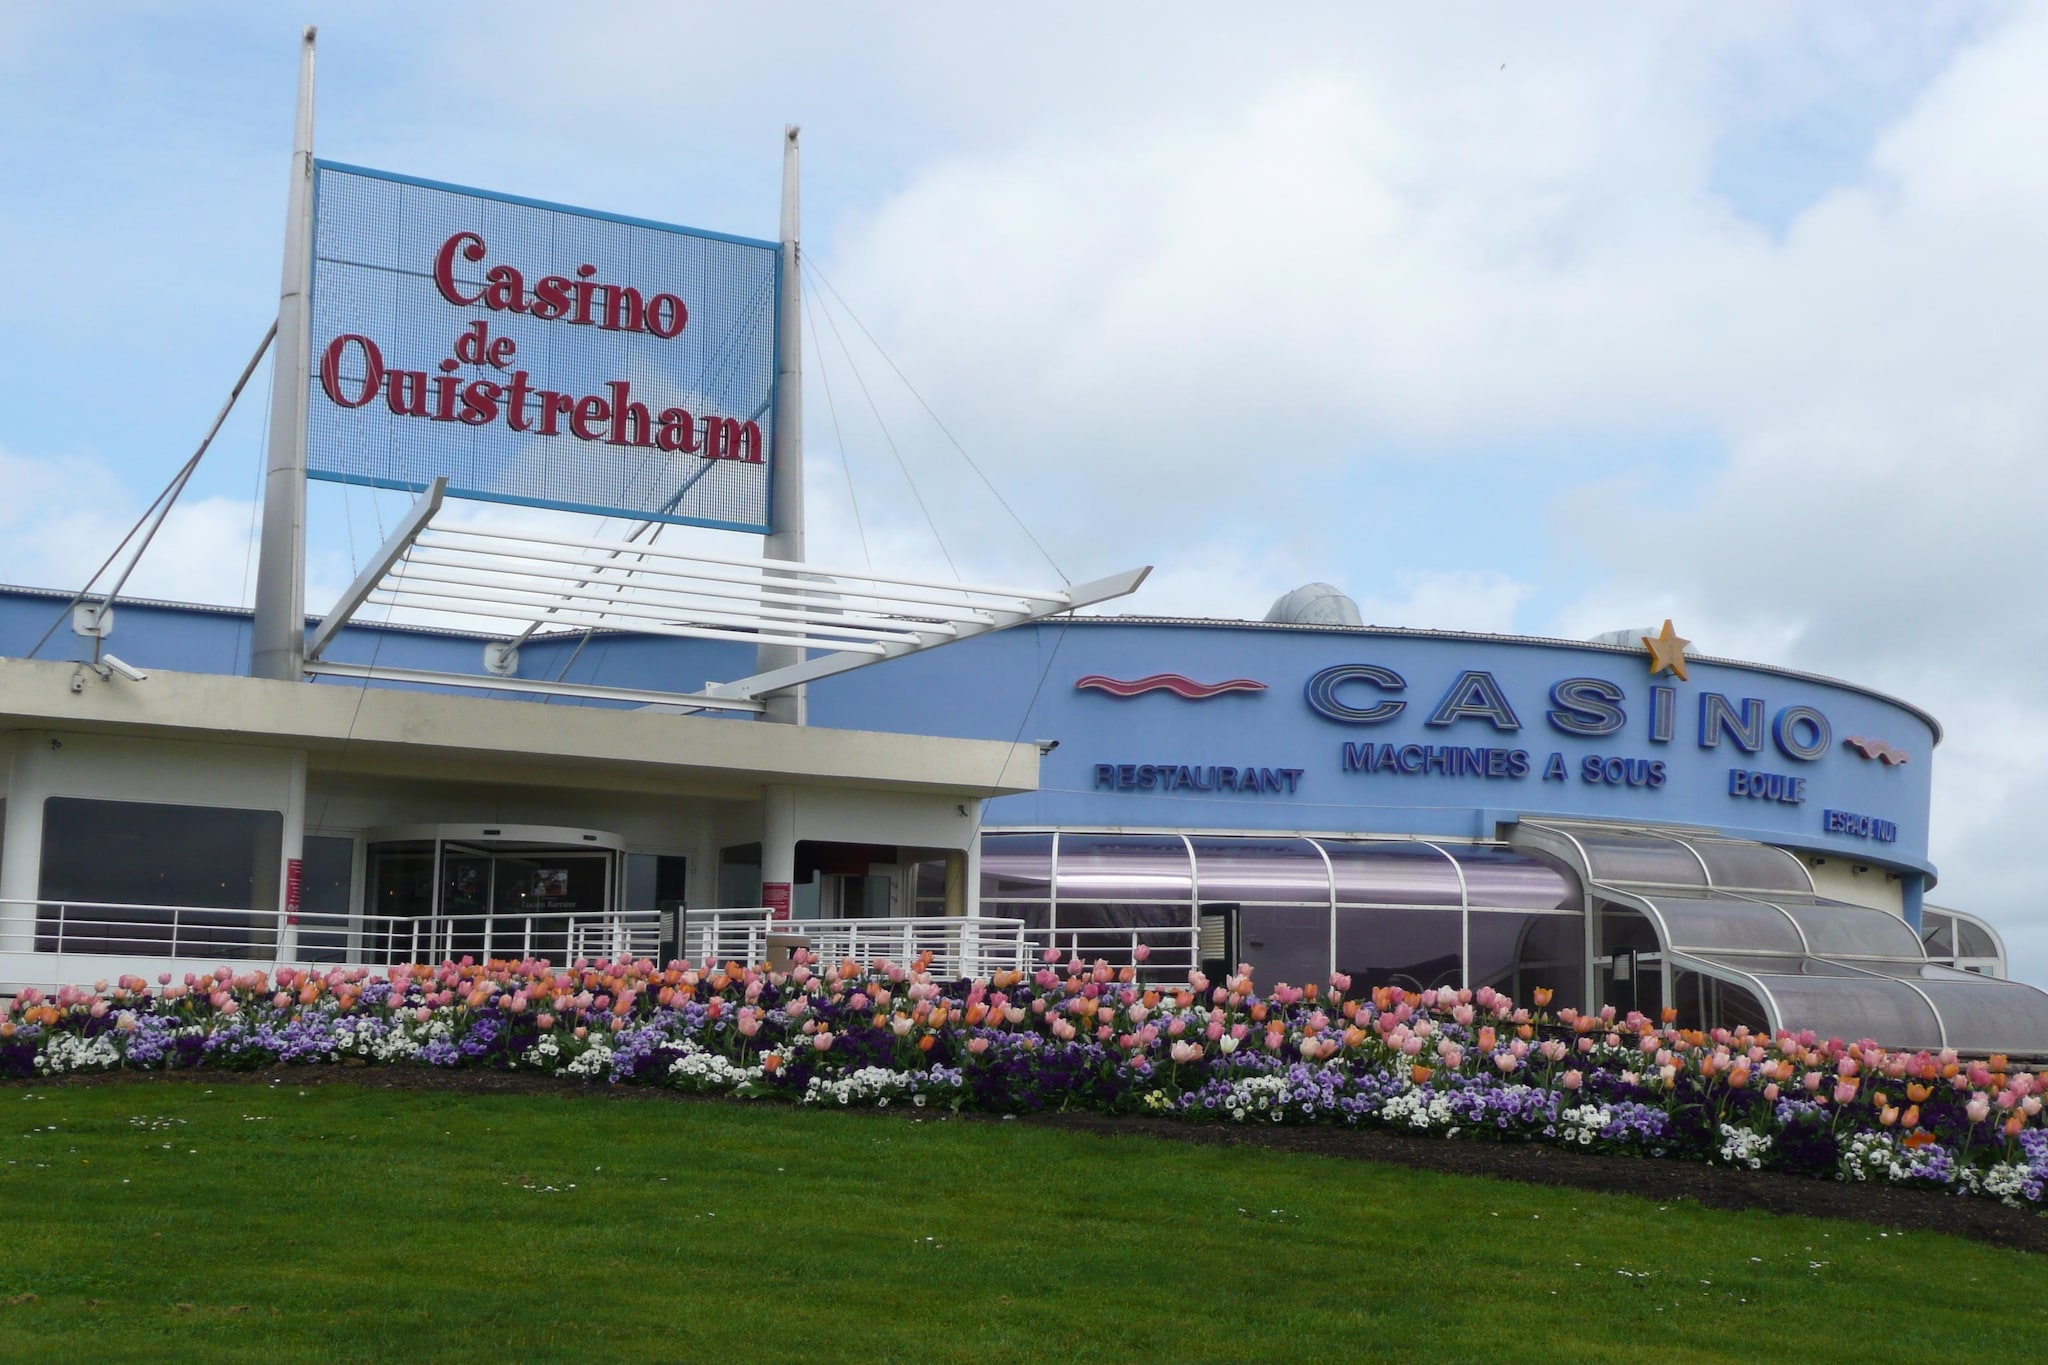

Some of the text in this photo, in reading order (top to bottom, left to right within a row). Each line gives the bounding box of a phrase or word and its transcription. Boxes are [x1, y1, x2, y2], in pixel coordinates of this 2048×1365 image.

[434, 231, 688, 338] Casino
[455, 320, 517, 368] de
[320, 333, 765, 465] Ouistreham
[1304, 663, 1832, 761] CASINO
[1094, 763, 1305, 793] RESTAURANT
[1342, 741, 1668, 788] MACHINES A SOUS
[1728, 768, 1807, 804] BOULE
[1823, 809, 1899, 842] ESPACE NUIT
